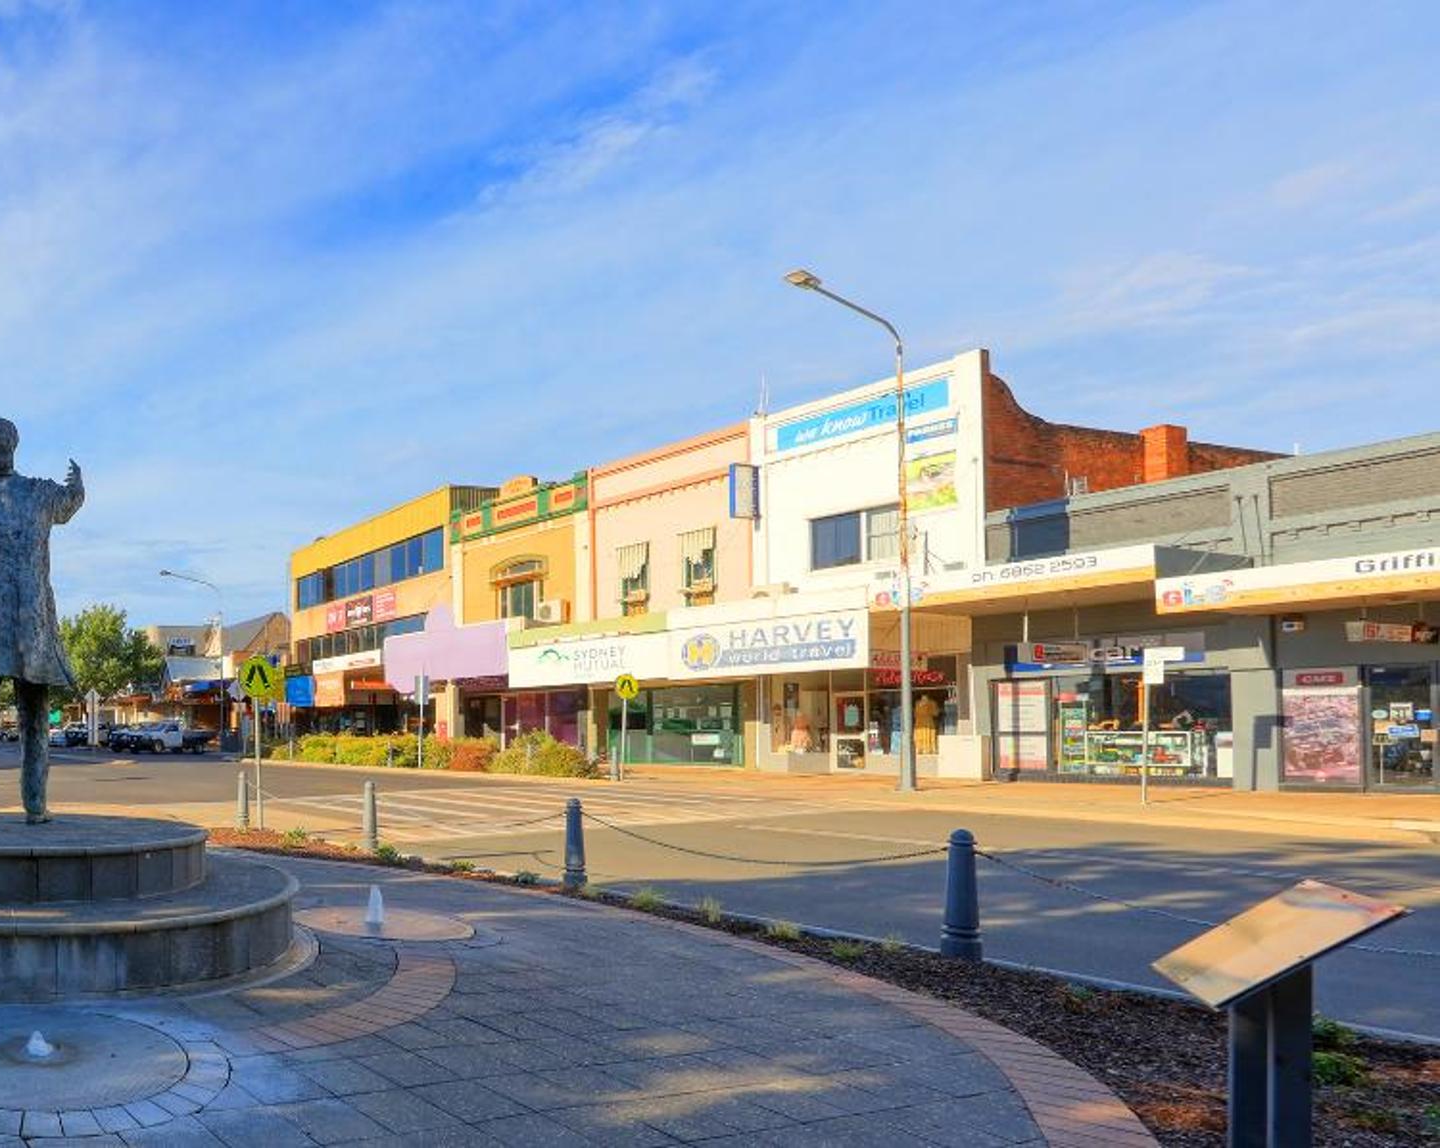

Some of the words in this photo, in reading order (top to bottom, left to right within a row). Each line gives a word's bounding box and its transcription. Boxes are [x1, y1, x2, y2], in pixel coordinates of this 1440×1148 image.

[820, 411, 867, 436] know
[869, 392, 925, 419] Trael
[728, 617, 854, 648] HARVEY
[573, 645, 626, 661] SYDNEY
[729, 648, 781, 664] world
[792, 642, 850, 659] travel
[573, 658, 628, 673] MUTUAL
